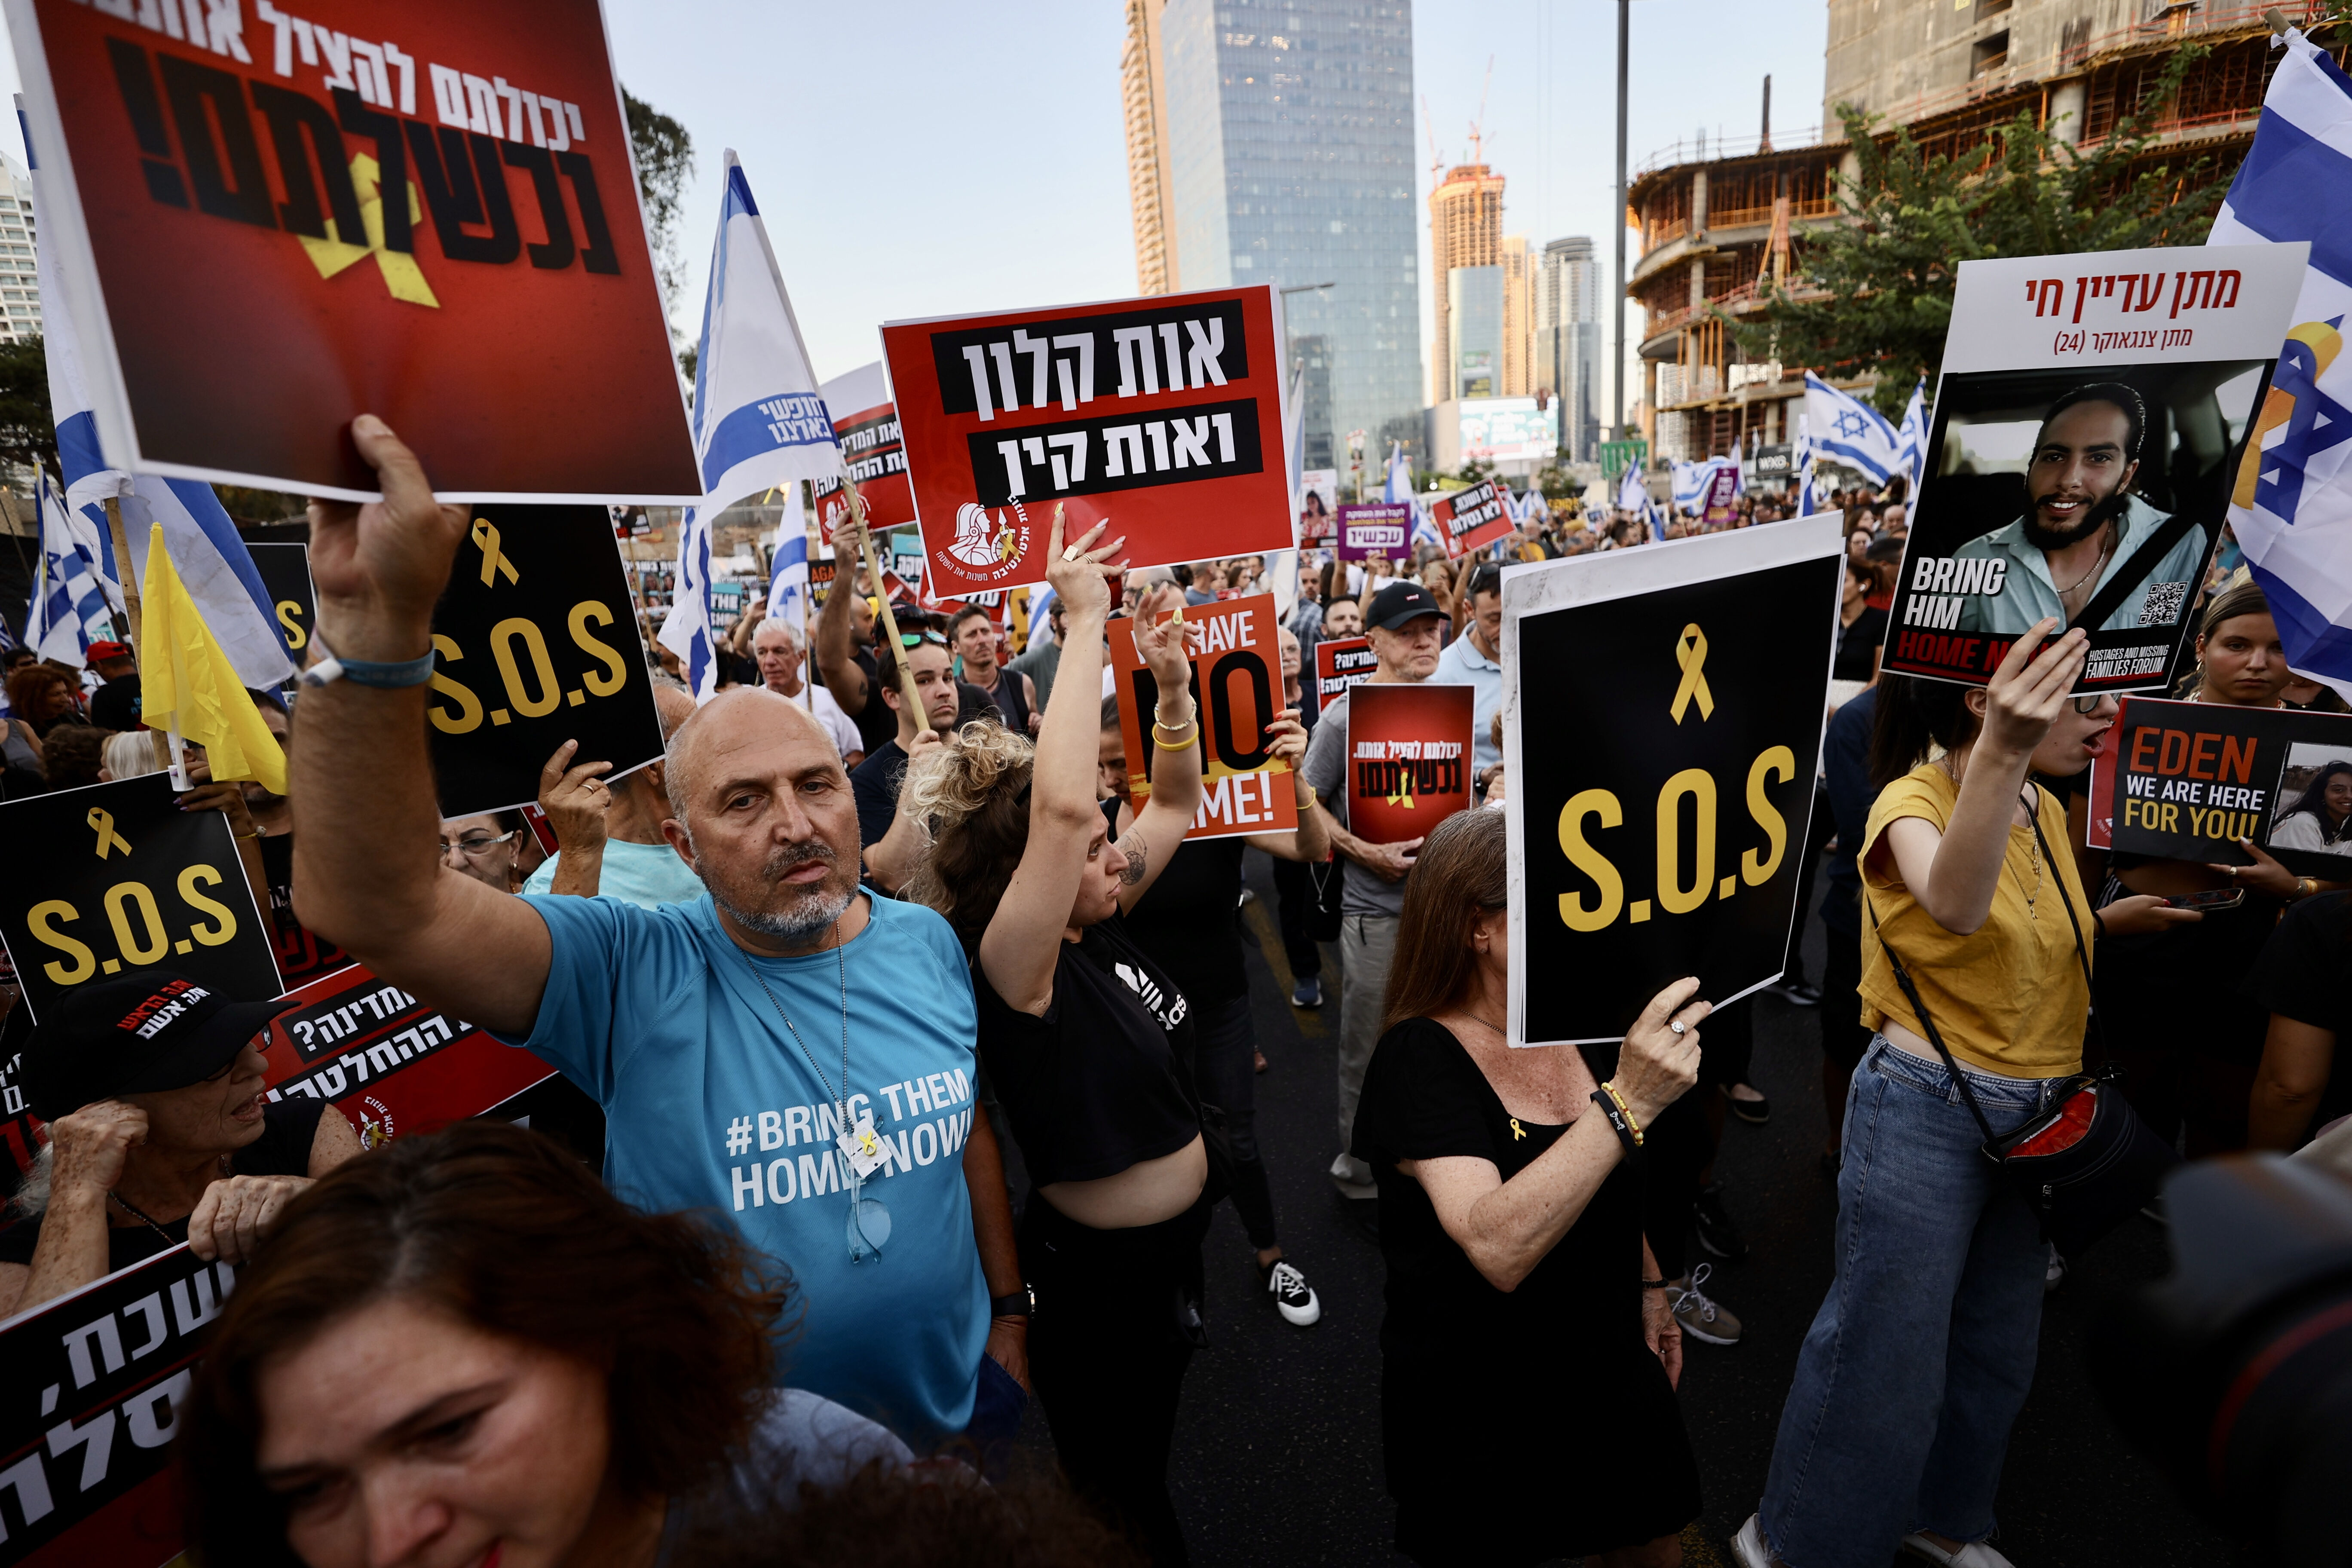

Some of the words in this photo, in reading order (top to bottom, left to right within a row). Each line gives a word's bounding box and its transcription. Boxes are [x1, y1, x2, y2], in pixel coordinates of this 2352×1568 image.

[82, 0, 252, 64] אות
[257, 0, 416, 114] להציל
[429, 63, 586, 151] יכולתם
[106, 35, 621, 276] נכשלתם!
[2025, 279, 2064, 317] חי
[2072, 273, 2165, 324] עדיין
[2169, 269, 2242, 319] מתן
[1113, 317, 1228, 398] אות
[2054, 330, 2086, 355] (24)
[2091, 332, 2157, 353] צנגאוקר
[2161, 328, 2193, 351] מתן
[962, 329, 1094, 422] קלון
[758, 395, 825, 421] חופשי
[768, 418, 832, 444] בארצנו
[840, 427, 877, 456] המדינ
[878, 421, 900, 444] את
[1102, 413, 1236, 478] ואות
[997, 431, 1088, 496] קין
[1479, 484, 1494, 502] לא
[1481, 499, 1501, 521] לא
[1351, 530, 1400, 543] עכשיו
[1446, 508, 1484, 536] נסלח!
[812, 565, 836, 583] AGA
[897, 555, 923, 578] סקה
[936, 551, 955, 570] השטח
[953, 567, 965, 578] את
[966, 571, 988, 581] משנות
[1911, 557, 2006, 594] BRING
[1903, 594, 1964, 629] HIM
[429, 600, 627, 735] S.O.S
[1335, 651, 1378, 670] המדינה?
[1896, 631, 1980, 669] HOME
[2085, 660, 2130, 679] FAMILIES
[2129, 656, 2166, 675] FORUM
[2089, 648, 2124, 662] HOSTAGES
[2124, 647, 2139, 658] AND
[2138, 645, 2169, 658] MISSING
[1353, 741, 1386, 759] אותם.
[1388, 740, 1421, 760] להציל
[1424, 741, 1462, 760] יכולתם
[2130, 726, 2257, 784] EDEN
[1358, 757, 1462, 798] נכשלתם!
[2127, 775, 2156, 798] WE
[2161, 779, 2203, 803] ARE
[2208, 785, 2265, 811] HERE
[1189, 770, 1274, 830] ME!
[1559, 745, 1795, 932] S.O.S
[2125, 799, 2179, 834] FOR
[2189, 806, 2258, 843] YOU!
[27, 864, 236, 985] S.O.S
[116, 995, 169, 1031] הראש
[136, 1000, 187, 1040] אשם
[293, 986, 416, 1052] מדינה?
[726, 1093, 874, 1157] #BRING
[879, 1068, 970, 1122] THEM
[882, 1107, 971, 1178] NOW!
[41, 1260, 236, 1418] שכח,
[0, 1367, 192, 1544] סלח
